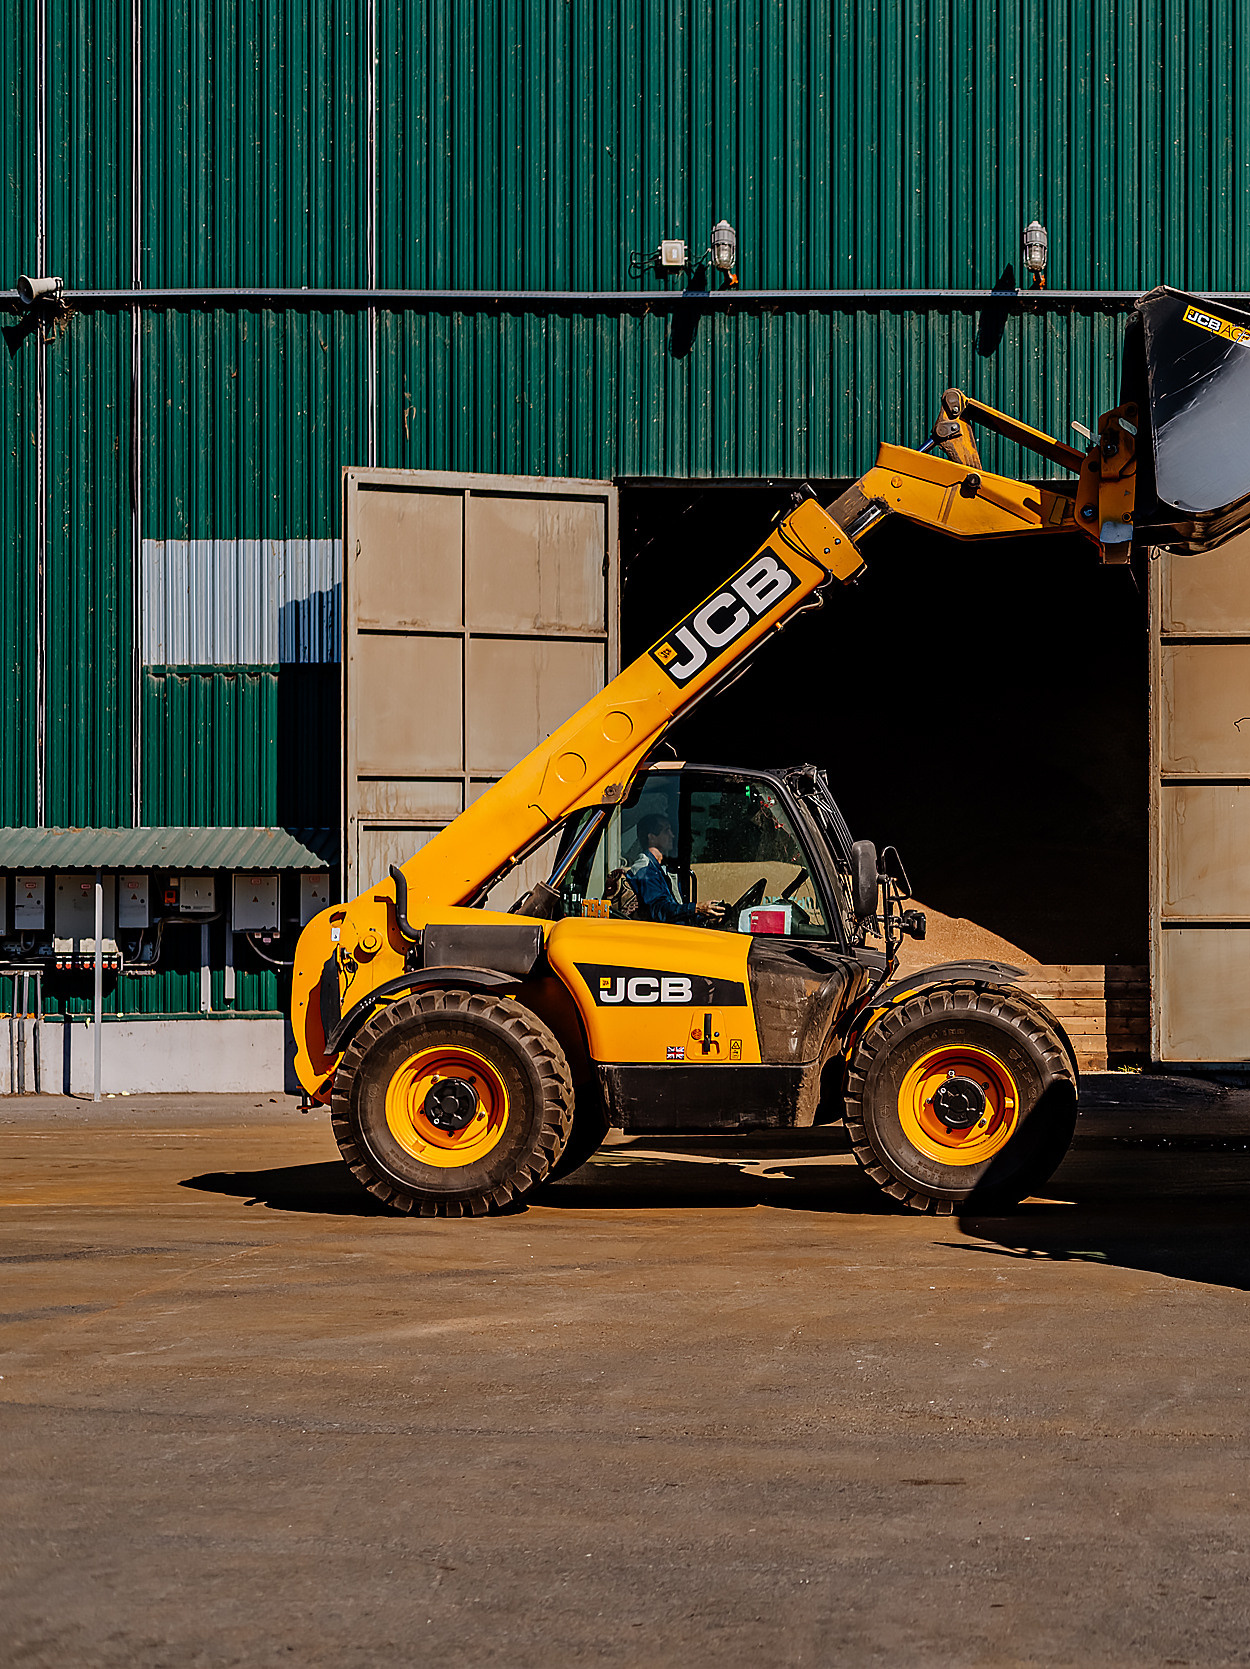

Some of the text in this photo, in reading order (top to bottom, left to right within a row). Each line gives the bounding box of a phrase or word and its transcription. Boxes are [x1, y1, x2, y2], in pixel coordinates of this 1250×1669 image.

[1188, 311, 1221, 331] JCB
[669, 557, 792, 679] JCB
[600, 977, 693, 1003] JCB
